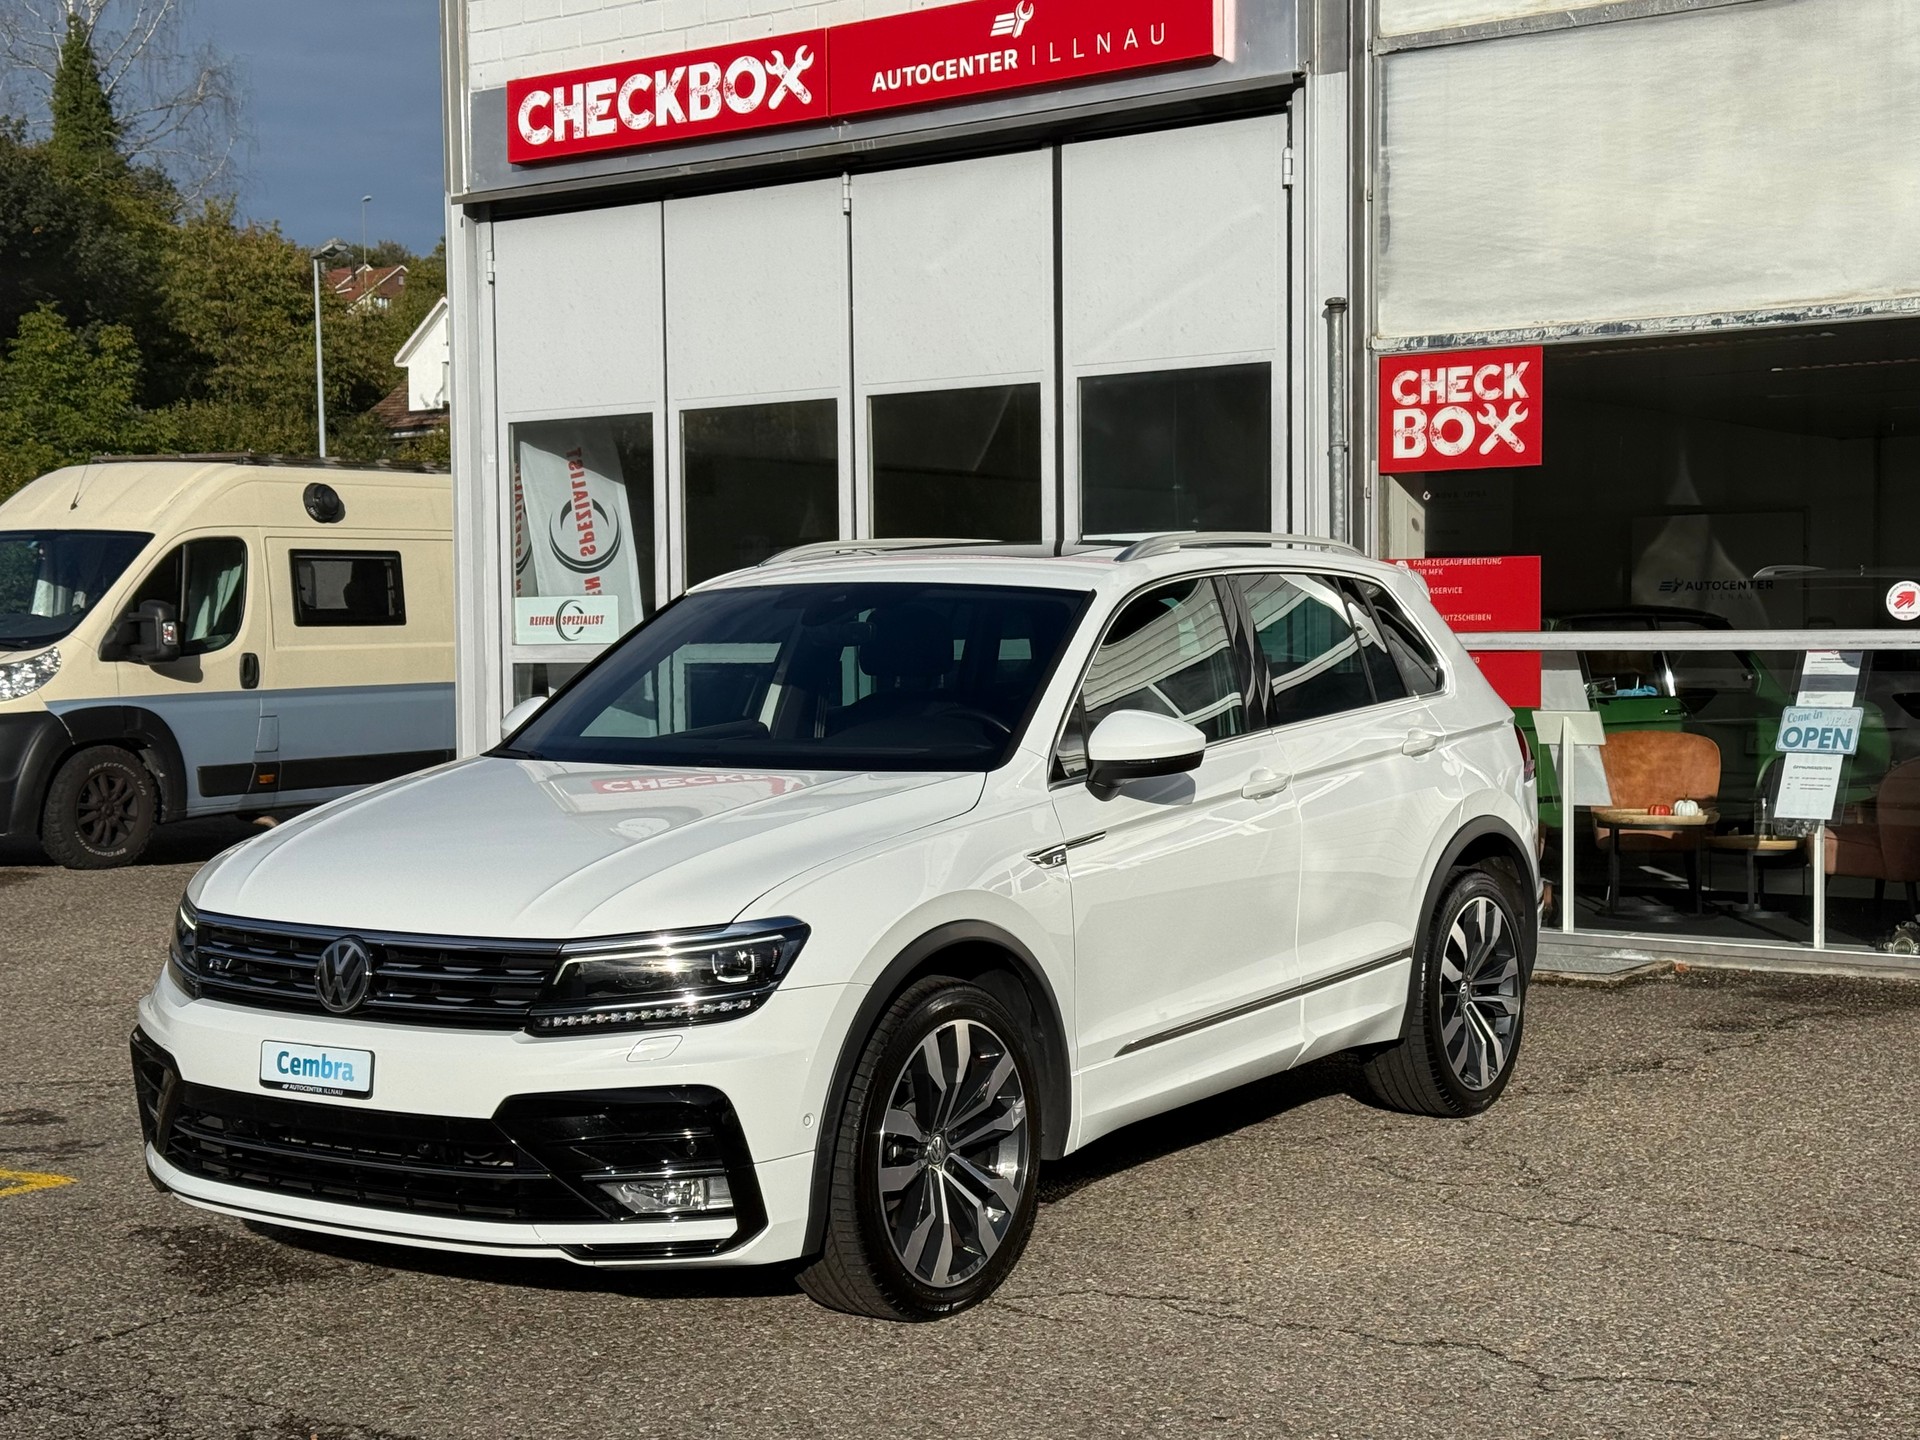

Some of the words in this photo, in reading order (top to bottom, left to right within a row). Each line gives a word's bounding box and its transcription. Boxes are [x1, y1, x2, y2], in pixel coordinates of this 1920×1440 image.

[871, 48, 1019, 92] AUTOCENTER
[1030, 22, 1168, 67] ILLNAU
[516, 43, 815, 146] CHECKBOX
[1391, 361, 1530, 406] CHECK
[1392, 401, 1530, 459] BOX
[1413, 558, 1502, 566] FAHRZEUGAUFBEREITUNG
[1684, 579, 1774, 591] AUTOCENTER
[529, 616, 555, 626] REIFEN
[561, 614, 605, 626] SPEZIALIST
[1787, 712, 1811, 723] Come
[1812, 709, 1823, 720] in
[1782, 726, 1854, 750] OPEN
[276, 1050, 355, 1082] Cembra
[289, 1083, 323, 1094] AUTOCENTER
[323, 1087, 344, 1096] ILLNAU
